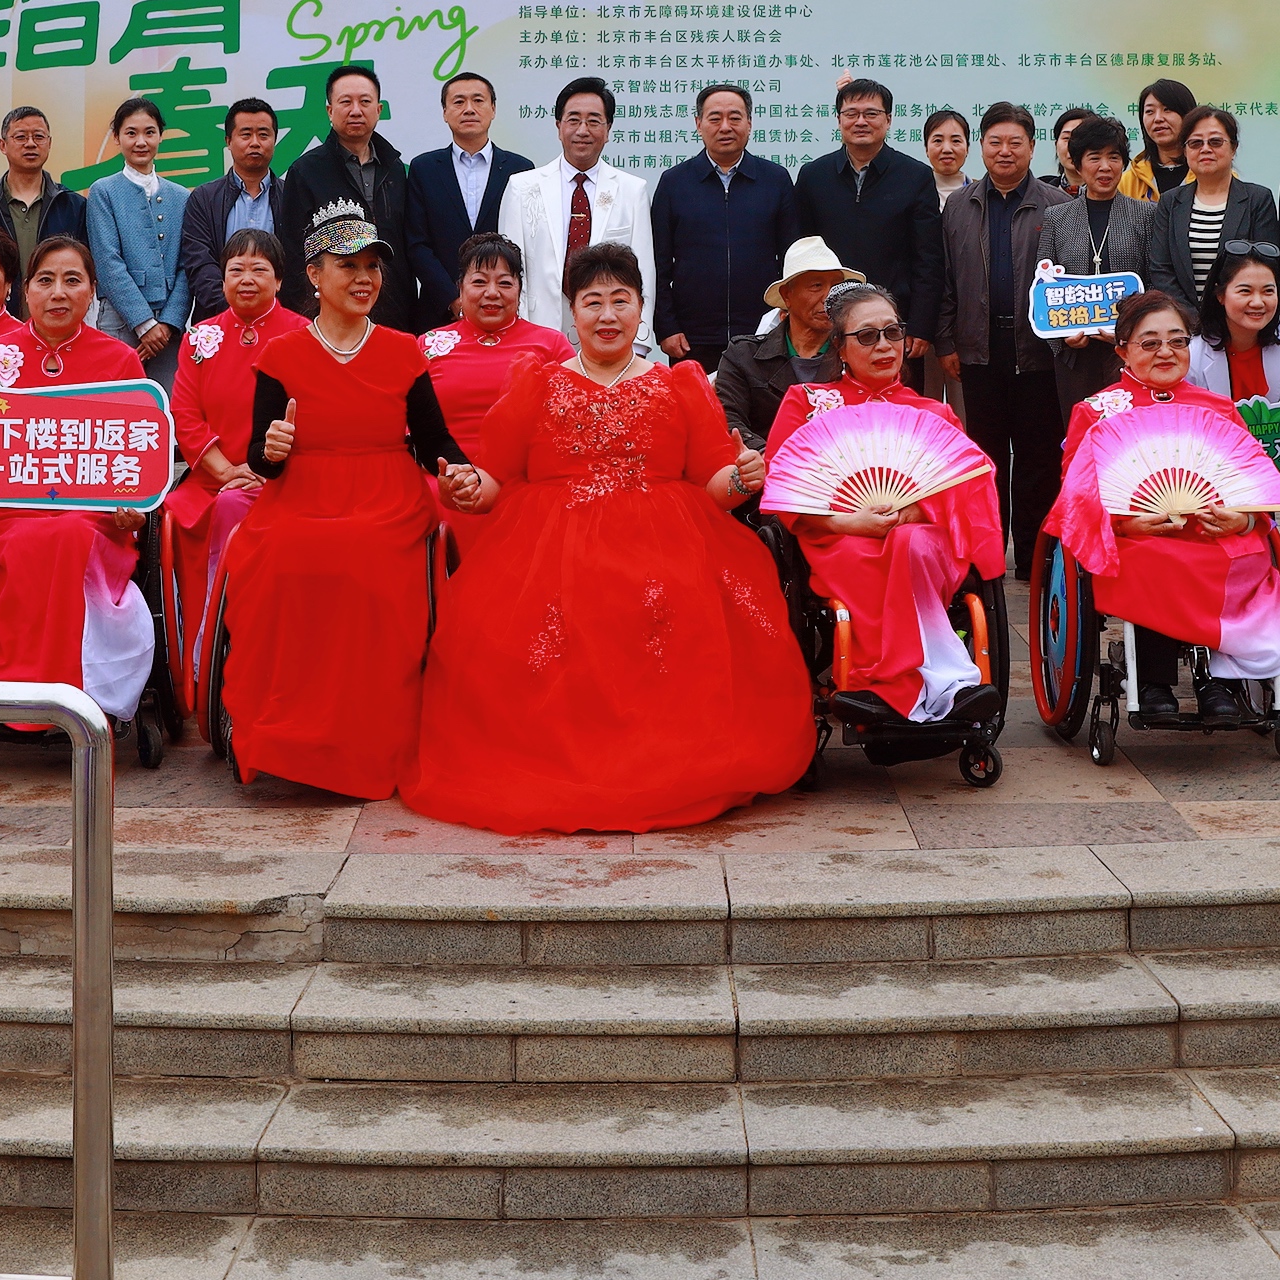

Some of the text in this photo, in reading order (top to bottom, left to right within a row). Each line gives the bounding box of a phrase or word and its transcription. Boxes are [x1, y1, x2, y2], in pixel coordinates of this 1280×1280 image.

[1045, 281, 1126, 307] 智龄出行
[1248, 422, 1280, 436] HAPPY
